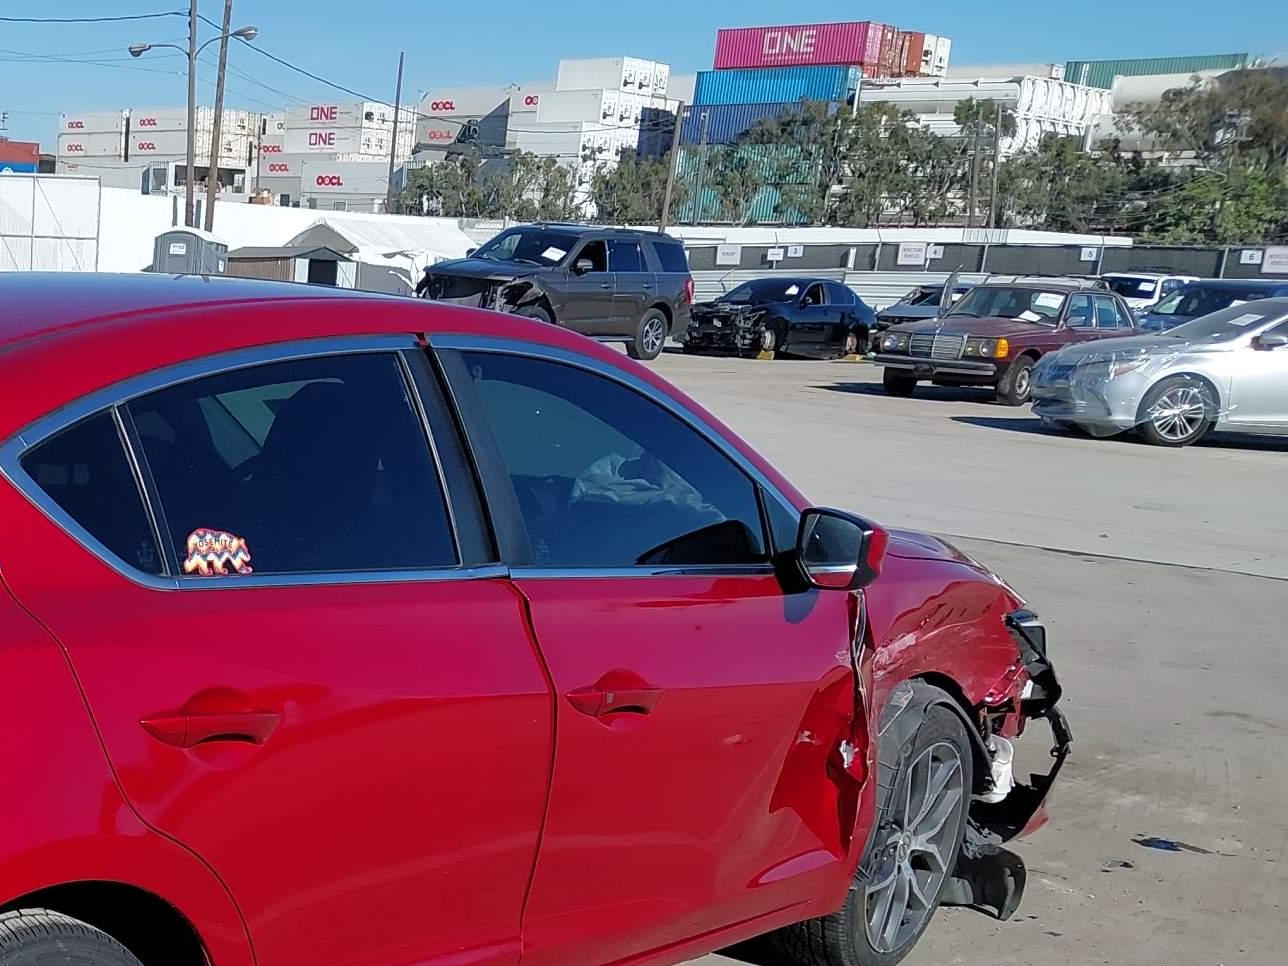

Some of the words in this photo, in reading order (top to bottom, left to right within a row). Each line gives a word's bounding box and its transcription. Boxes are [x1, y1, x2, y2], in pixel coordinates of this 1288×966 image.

[762, 29, 816, 54] ONE
[431, 101, 455, 111] OOCL
[310, 106, 338, 120] ONE
[68, 121, 84, 129] OOCL
[139, 118, 157, 127] OOCL
[429, 129, 452, 139] OOCL
[308, 132, 336, 146] ONE
[67, 143, 84, 151] OOCL
[138, 142, 156, 150] OOCL
[269, 163, 289, 172] OOCL
[316, 175, 343, 186] OOCL
[1088, 250, 1094, 258] 5
[1248, 253, 1255, 261] 6
